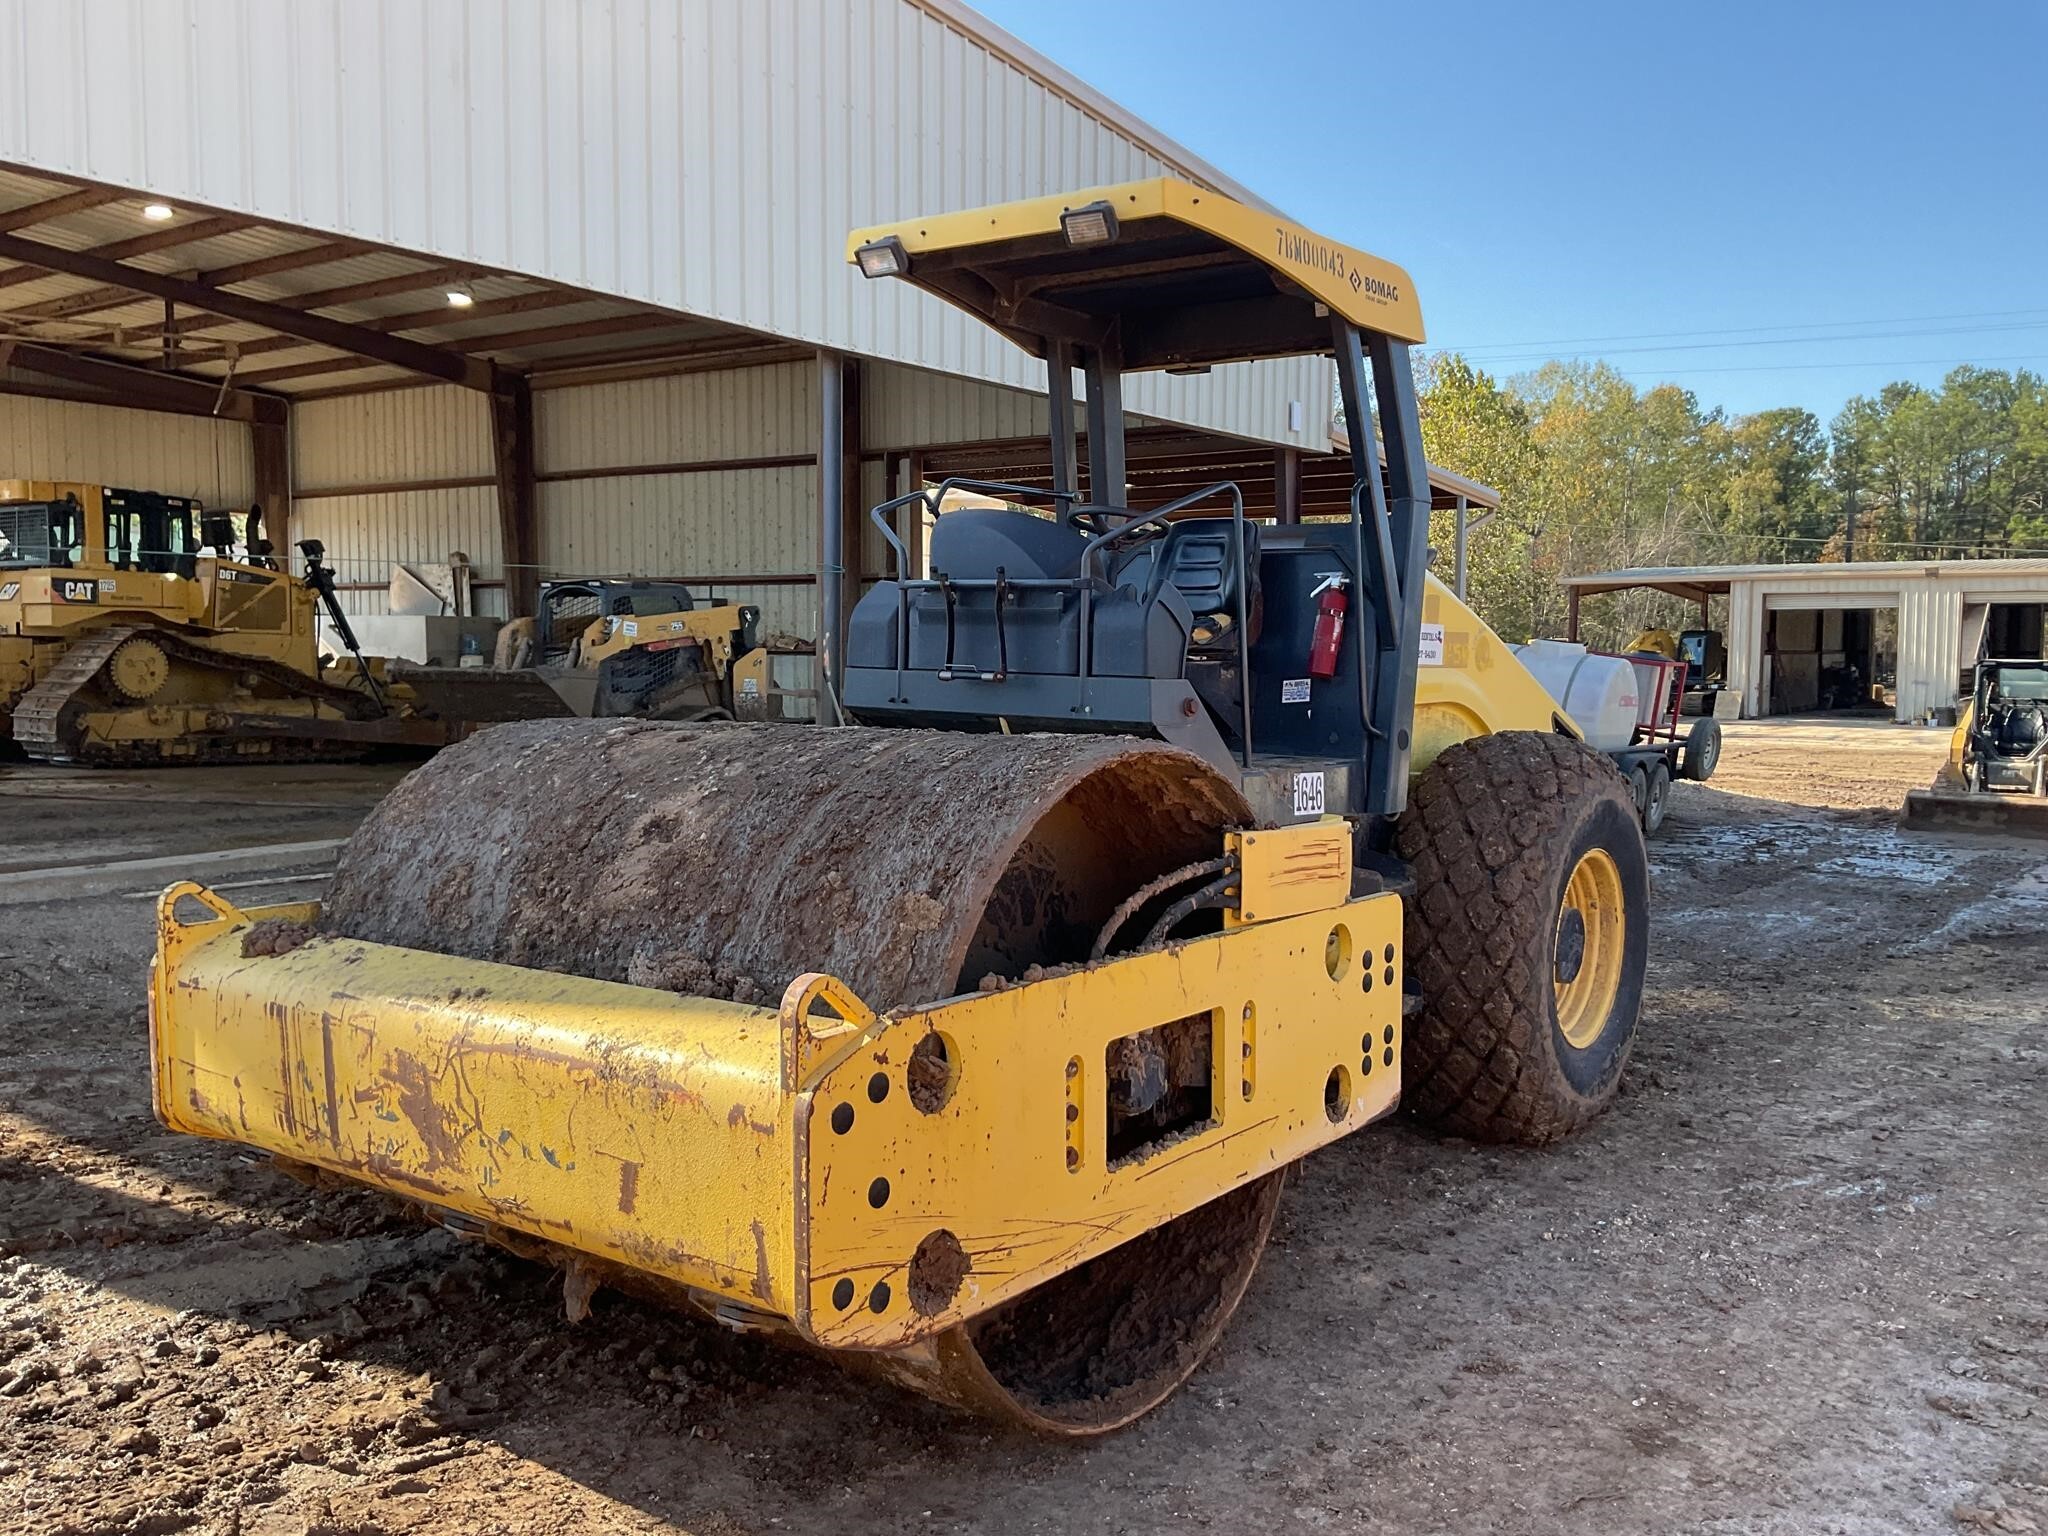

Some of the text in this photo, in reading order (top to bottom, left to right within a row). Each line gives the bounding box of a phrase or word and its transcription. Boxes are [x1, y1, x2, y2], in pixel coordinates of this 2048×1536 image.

[1365, 276, 1399, 302] BOMAG
[219, 568, 238, 581] D6T
[65, 581, 94, 601] CAT
[1296, 775, 1323, 812] 1646
